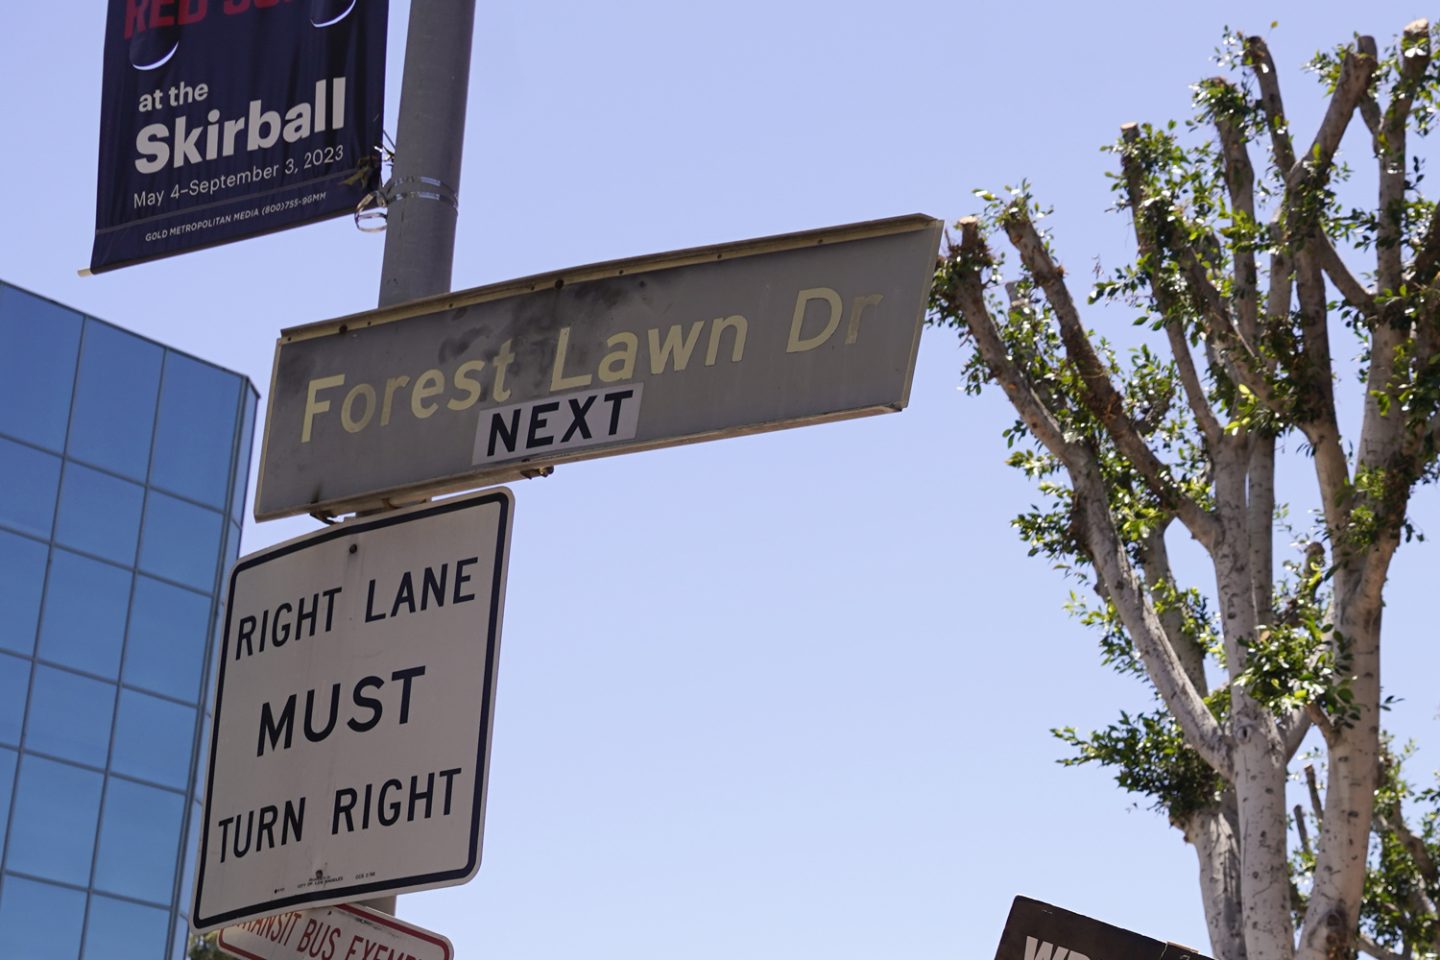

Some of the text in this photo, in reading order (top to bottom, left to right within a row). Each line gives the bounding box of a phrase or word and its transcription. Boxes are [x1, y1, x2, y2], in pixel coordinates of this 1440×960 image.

[134, 76, 347, 175] Skirball
[138, 82, 209, 113] at the
[133, 190, 165, 209] May
[284, 158, 299, 176] 3,
[303, 144, 345, 170] 2023
[145, 229, 168, 242] GOLD
[169, 214, 231, 237] METROPOLITAN
[233, 208, 260, 223] MEDIA
[301, 286, 884, 444] Forest Lawn Dr
[485, 389, 635, 457] NEXT
[235, 556, 479, 661] RIGHT LANE
[256, 665, 427, 758] MUST
[217, 767, 462, 863] TURN RIGHT
[235, 911, 302, 947] ANSIT
